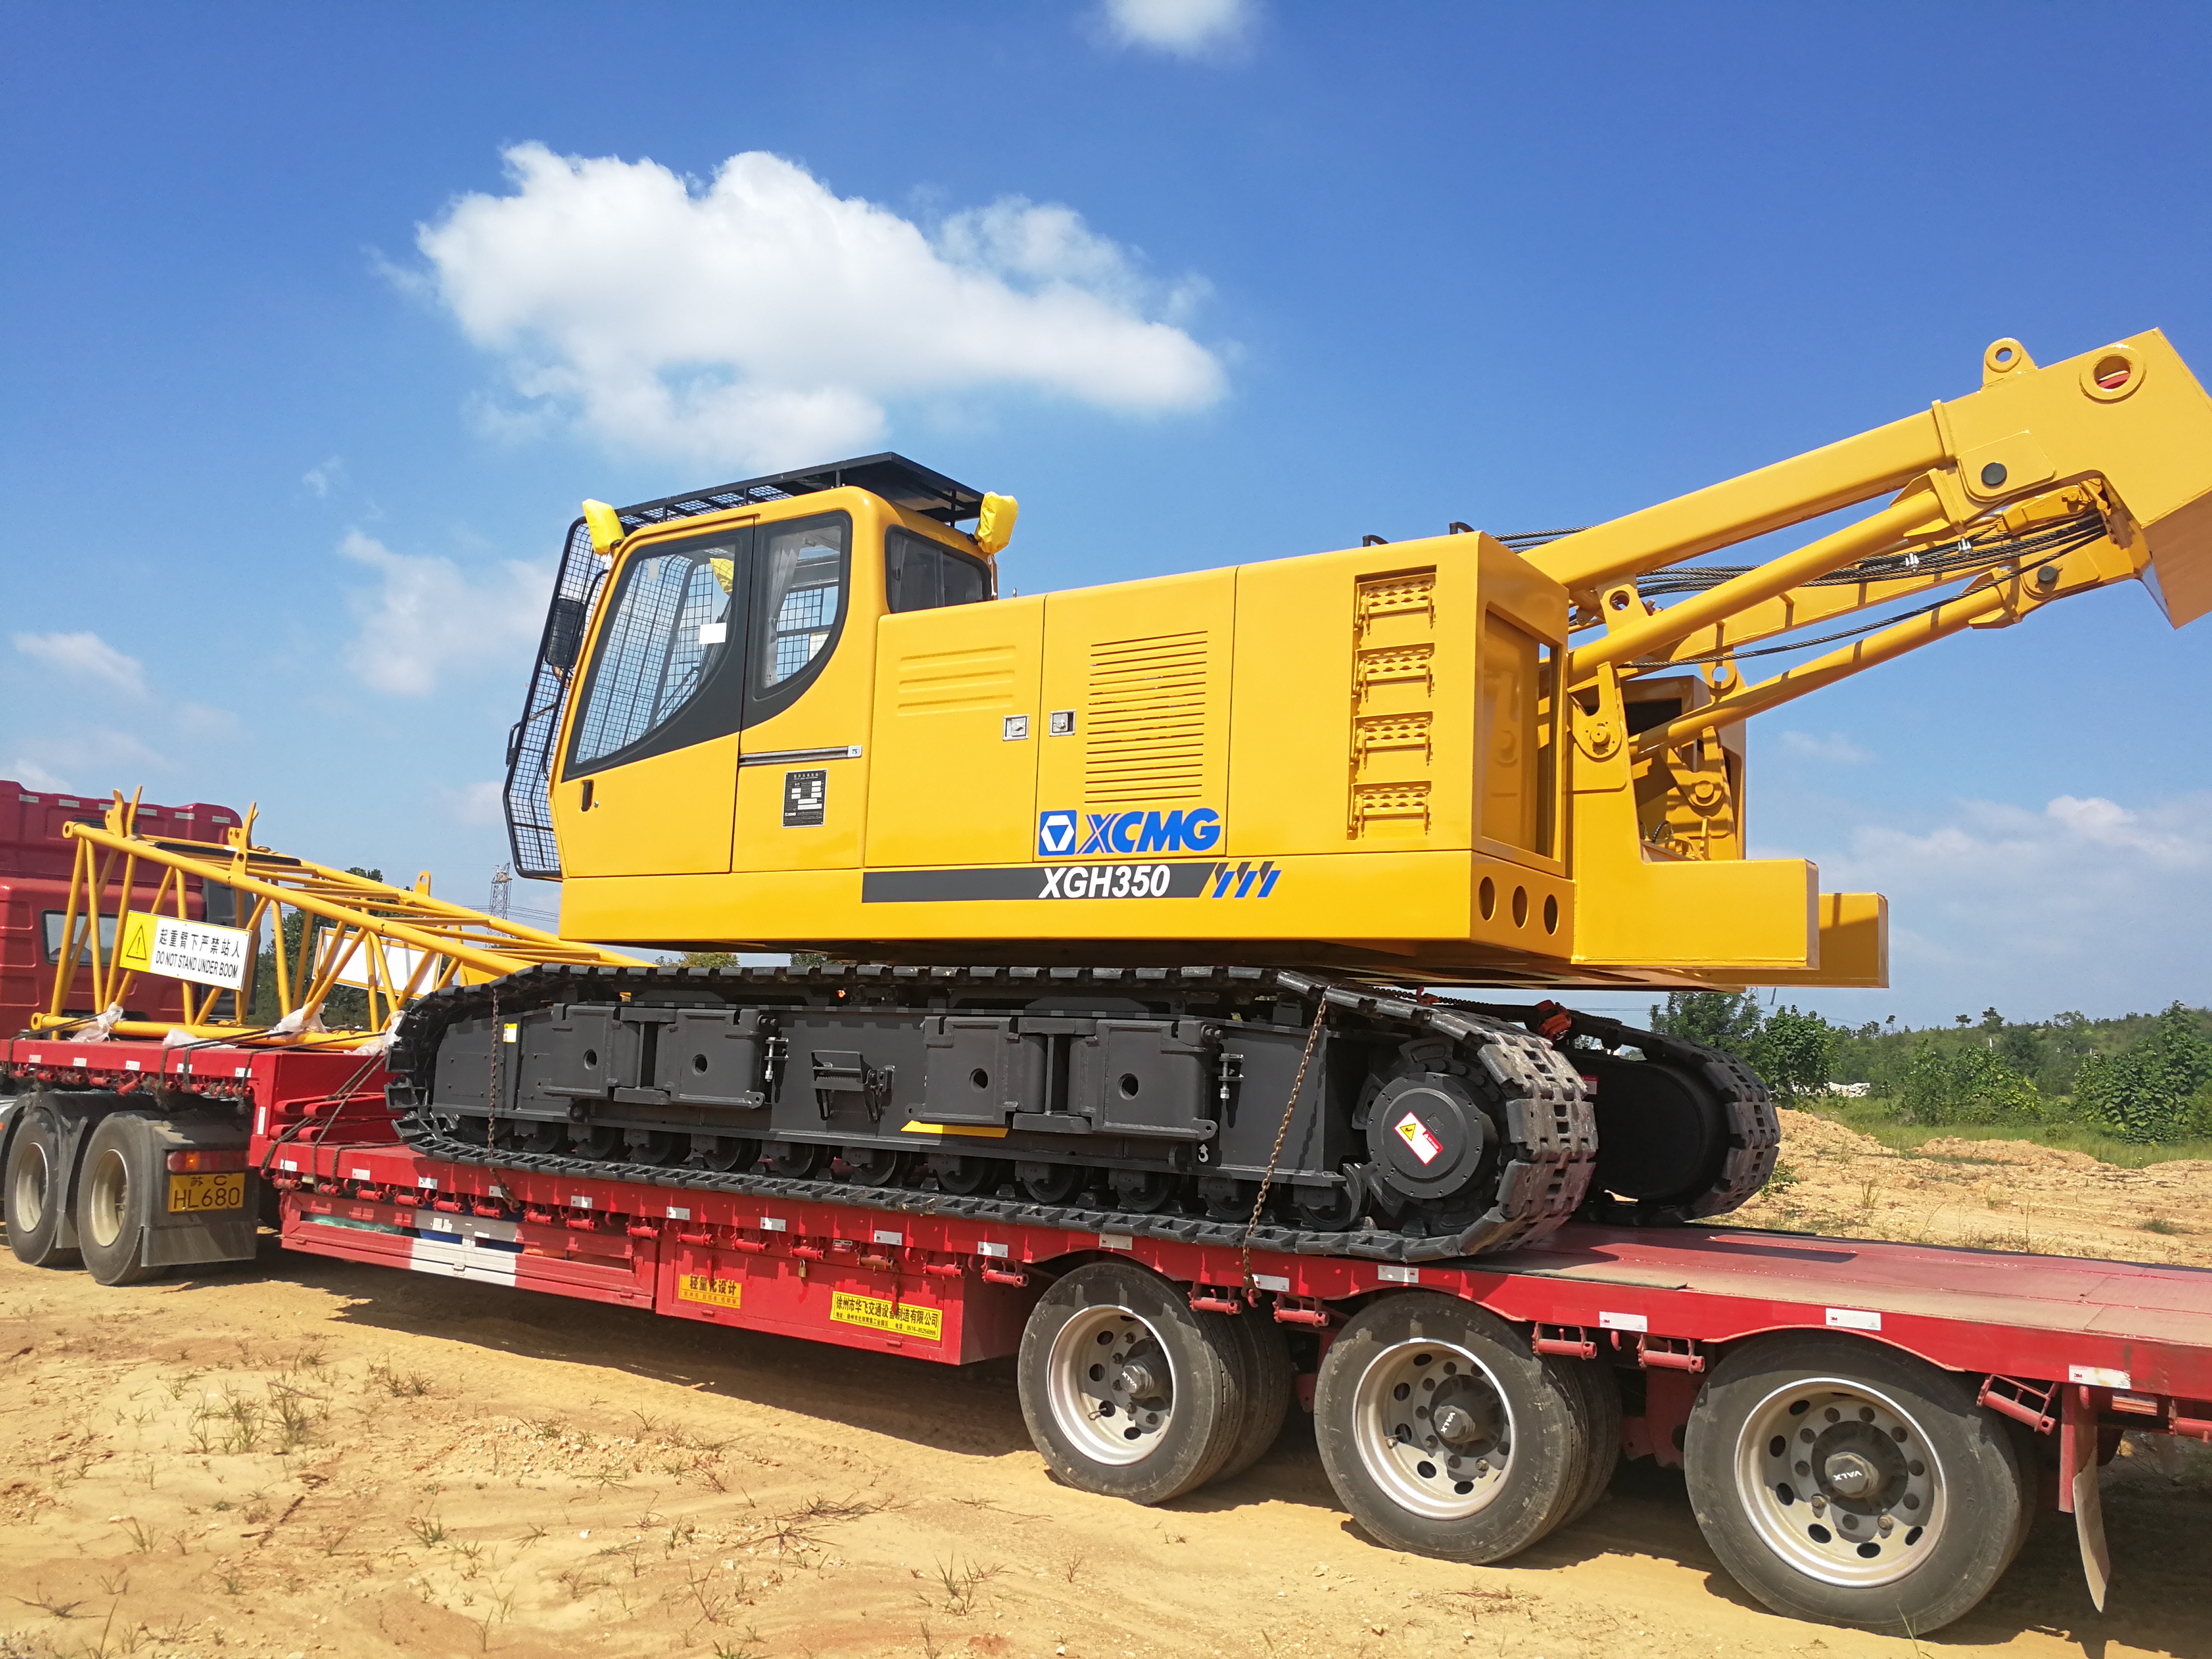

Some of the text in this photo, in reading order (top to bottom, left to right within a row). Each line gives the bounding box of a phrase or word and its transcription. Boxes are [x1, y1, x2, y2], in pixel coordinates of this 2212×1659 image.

[1076, 807, 1221, 854] XCMG
[1038, 865, 1170, 898] XGH350
[159, 928, 239, 958] 起重臂下严禁站人
[156, 950, 238, 979] DO NOT STAND UNDER BOOM
[174, 1187, 240, 1209] HL680
[690, 1274, 736, 1296] 轻量化设计
[836, 1295, 938, 1328] 徐州市华飞交通设备制造有限公司
[1440, 1412, 1456, 1433] VALX
[1833, 1471, 1862, 1481] VALX
